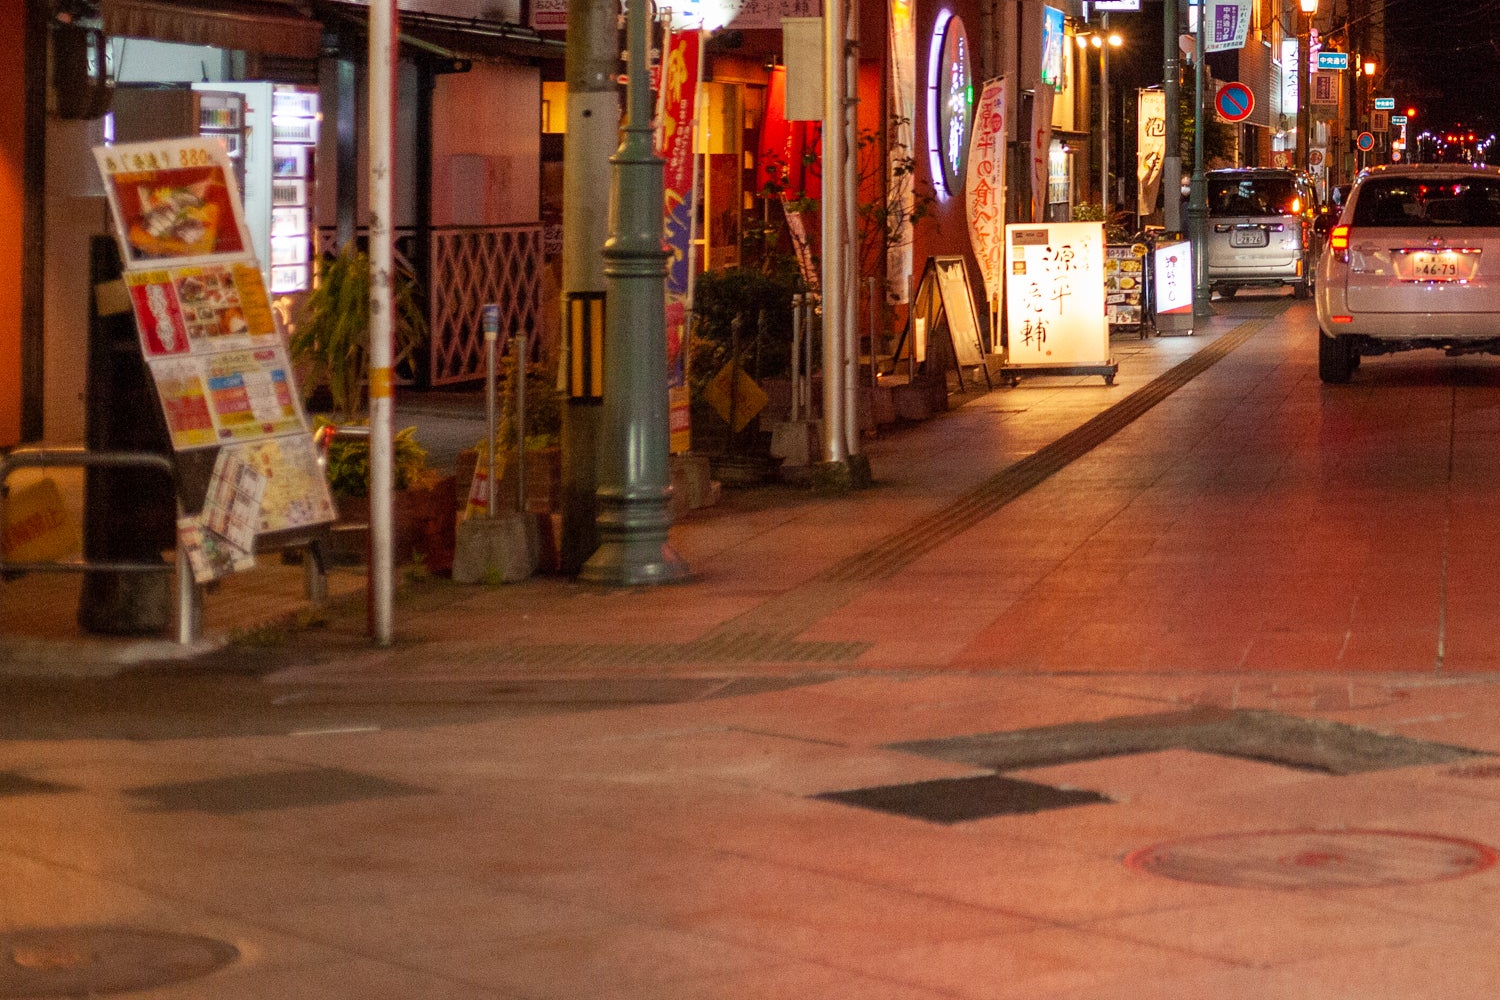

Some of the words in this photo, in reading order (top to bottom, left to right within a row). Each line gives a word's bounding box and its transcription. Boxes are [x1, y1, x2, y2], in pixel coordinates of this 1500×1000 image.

[1319, 56, 1347, 65] 中央通り
[1423, 263, 1456, 275] 46-79
